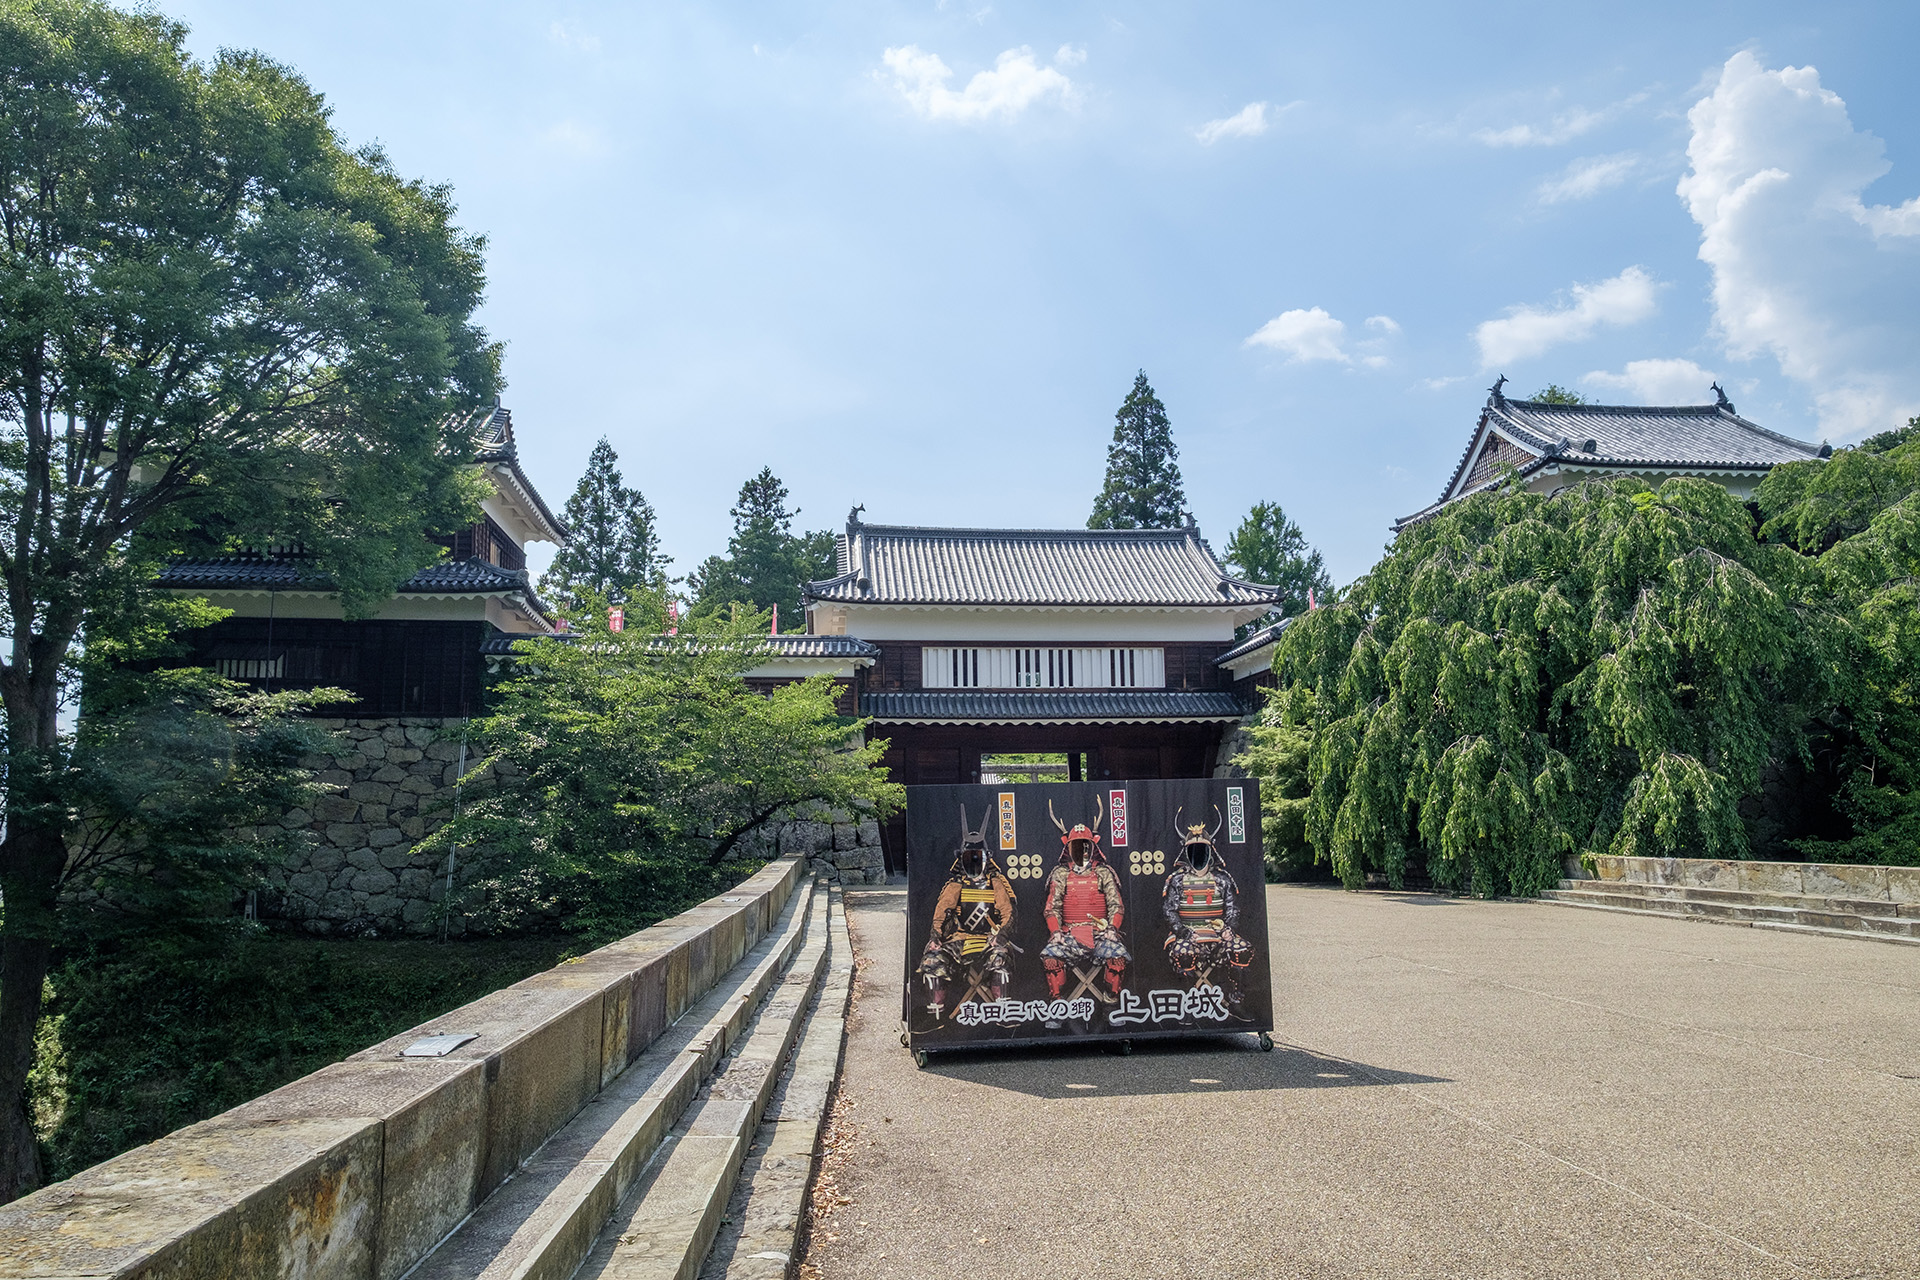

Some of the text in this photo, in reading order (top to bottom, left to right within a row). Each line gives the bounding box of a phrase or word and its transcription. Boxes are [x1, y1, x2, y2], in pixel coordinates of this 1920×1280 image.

[1112, 797, 1125, 838] 真田幸村
[957, 999, 1094, 1025] 真田三代の郷
[1109, 984, 1228, 1023] 上田城
